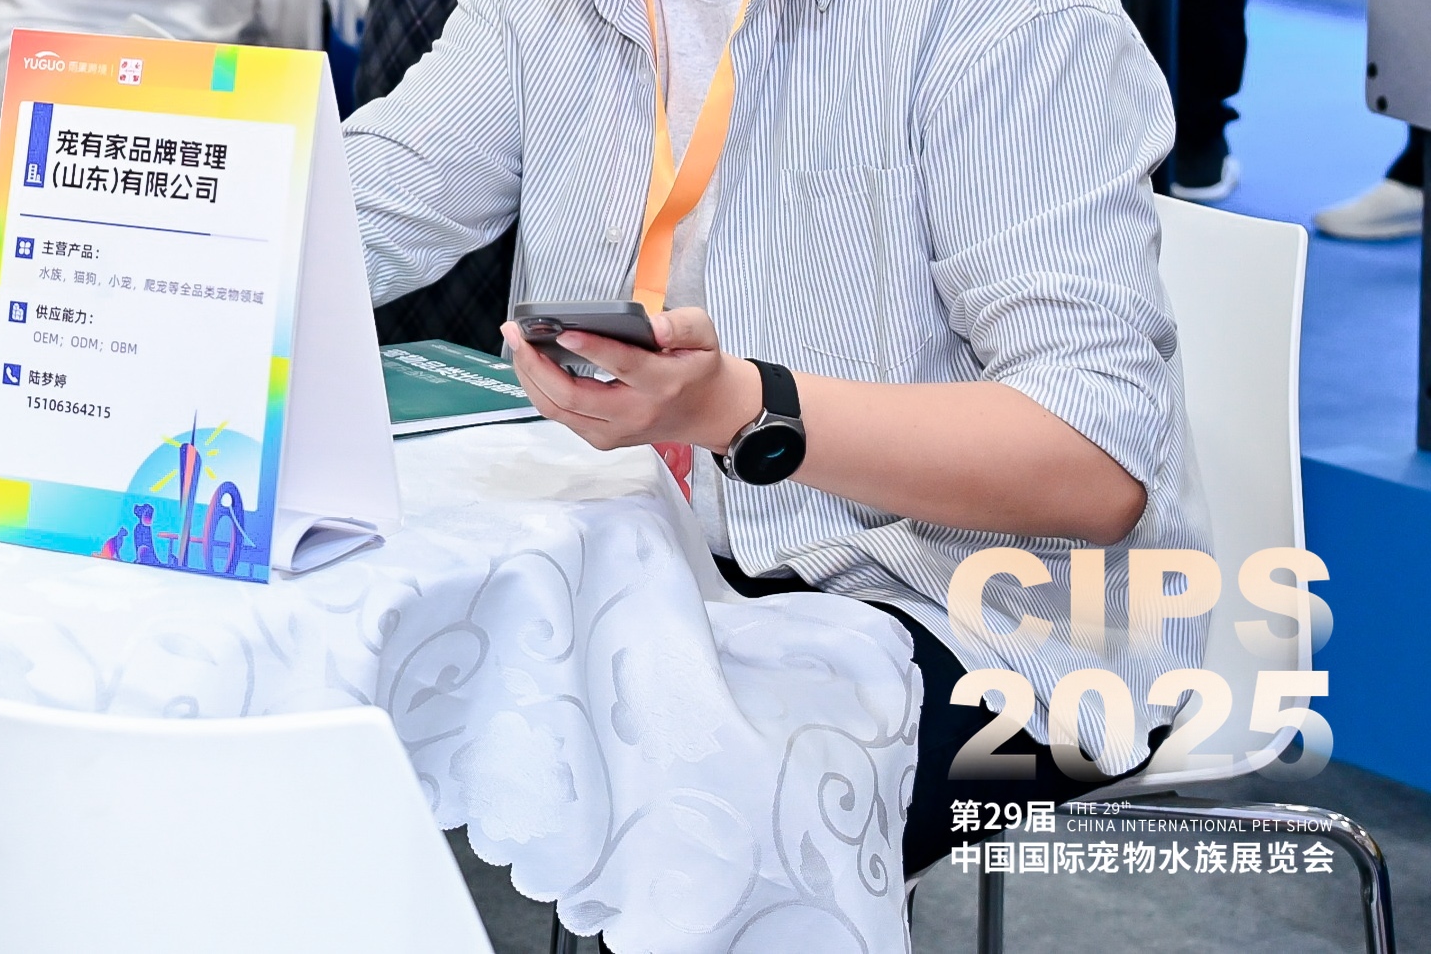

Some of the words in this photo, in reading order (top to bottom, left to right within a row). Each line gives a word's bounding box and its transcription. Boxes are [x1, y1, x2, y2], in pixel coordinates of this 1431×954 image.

[23, 56, 66, 72] YUGUO
[55, 129, 228, 170] 宠有家品牌管理
[52, 161, 219, 203] (山东)有限公司
[28, 370, 67, 389] 陆梦婷
[26, 396, 112, 419] 15106364215
